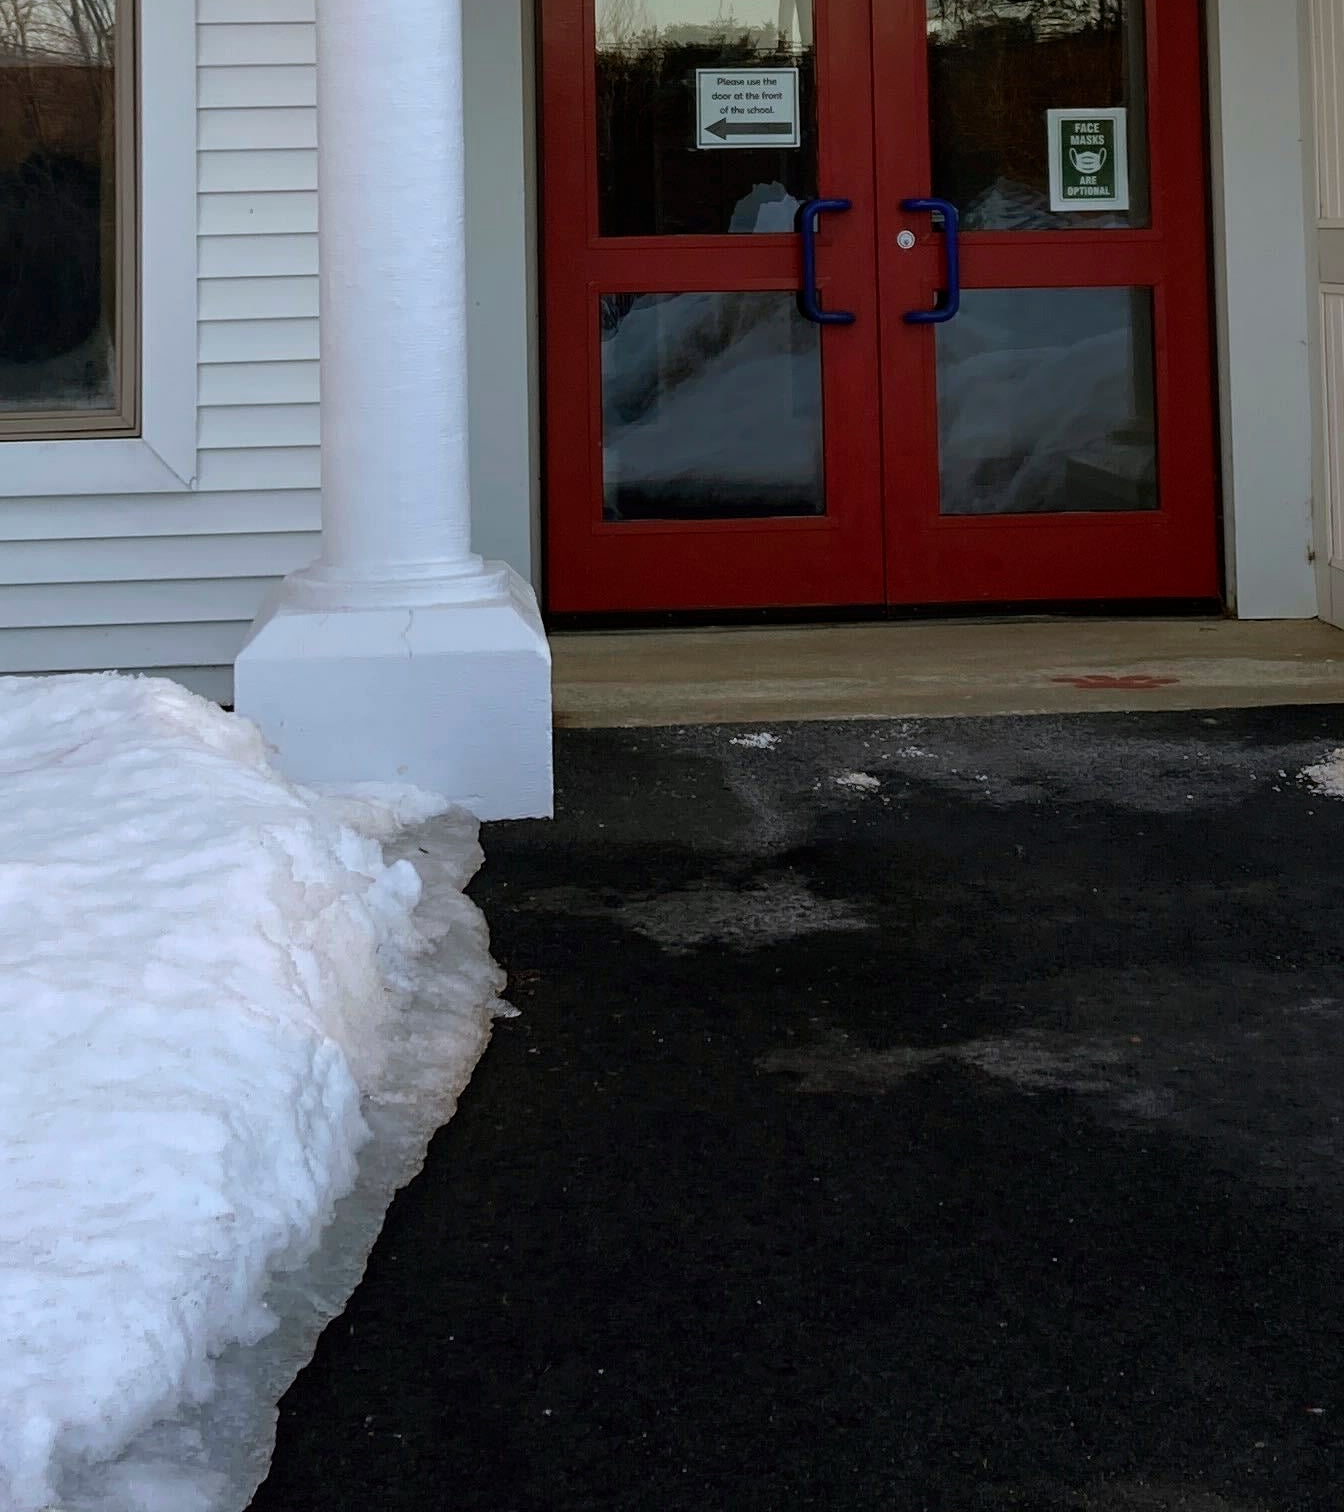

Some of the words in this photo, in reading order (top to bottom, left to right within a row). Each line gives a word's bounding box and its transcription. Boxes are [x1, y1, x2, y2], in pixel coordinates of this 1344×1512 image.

[716, 77, 745, 86] Please
[762, 77, 777, 86] the
[711, 92, 732, 100] door
[733, 92, 744, 100] at
[745, 92, 759, 100] the
[761, 91, 783, 100] front
[719, 106, 729, 114] of
[730, 106, 745, 114] the
[746, 106, 775, 114] school.
[1074, 122, 1100, 133] FACE
[1070, 134, 1105, 145] MASKS
[1079, 175, 1097, 185] ARE
[1067, 186, 1111, 196] OPTIONAL
